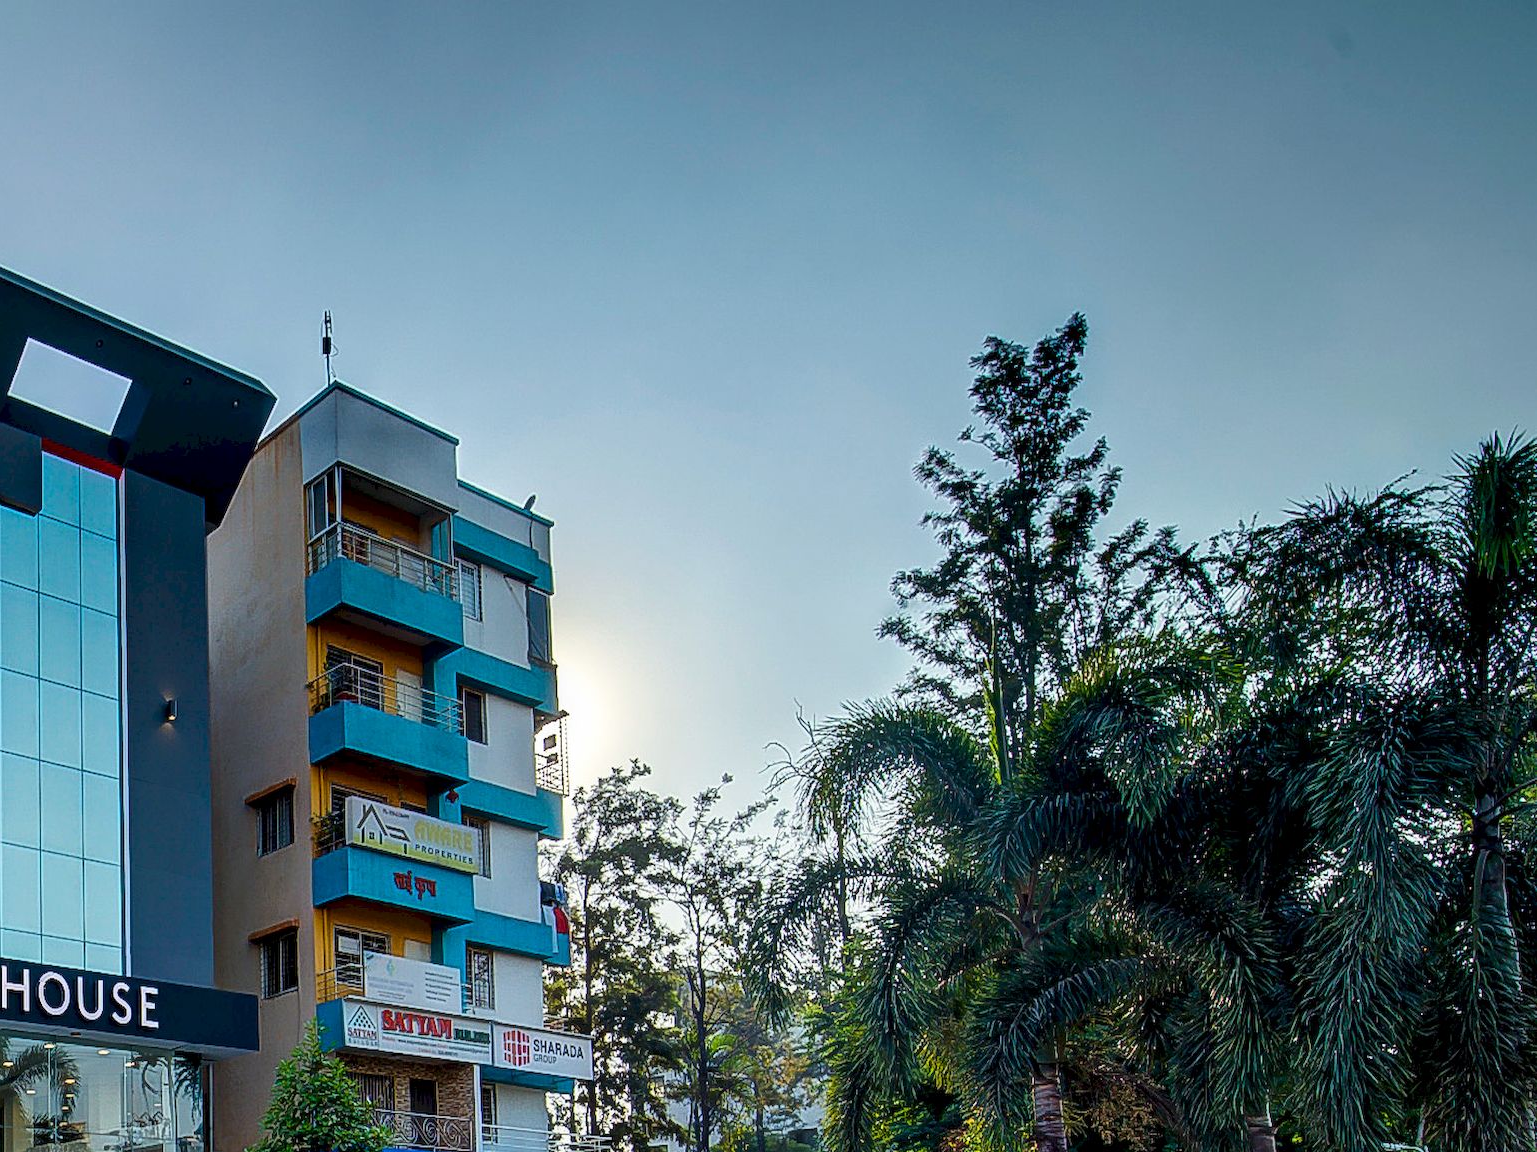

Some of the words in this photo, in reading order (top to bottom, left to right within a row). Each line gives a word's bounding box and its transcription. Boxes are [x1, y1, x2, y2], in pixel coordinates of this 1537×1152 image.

[415, 844, 474, 865] PROPERTIES
[347, 1027, 377, 1040] SATYAM
[381, 1008, 453, 1039] SATYAM
[533, 1039, 584, 1060] SHARADA
[533, 1053, 557, 1064] GROUP
